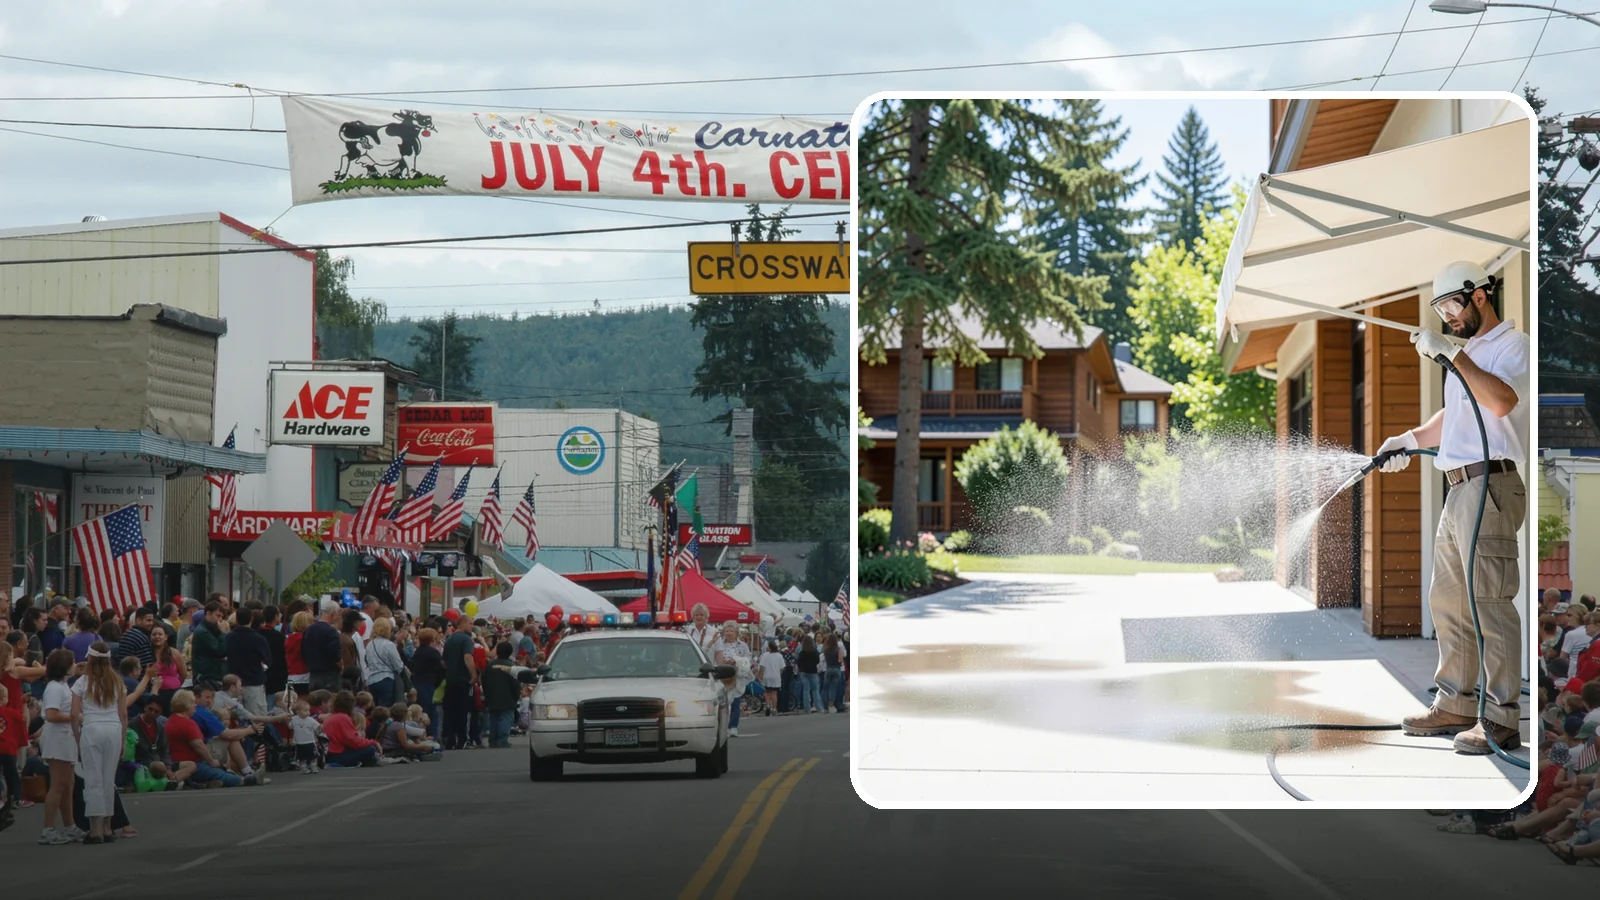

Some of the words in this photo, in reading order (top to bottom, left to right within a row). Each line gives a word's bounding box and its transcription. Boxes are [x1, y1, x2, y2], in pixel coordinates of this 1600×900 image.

[481, 140, 604, 192] JULY
[632, 149, 747, 198] 4th.
[697, 254, 850, 280] CROSSWA
[283, 380, 373, 420] ACE
[405, 408, 452, 422] CEDAR
[461, 409, 485, 422] LOG
[283, 421, 370, 436] Hardware
[416, 428, 477, 447] Coca-Cola
[353, 467, 385, 479] Simpl
[83, 485, 94, 494] St.
[95, 485, 124, 495] Vincent
[126, 485, 136, 495] de
[137, 486, 155, 495] Paul
[212, 515, 330, 536] HARDARE
[688, 526, 741, 535] CRNATION
[699, 535, 730, 543] GLASS
